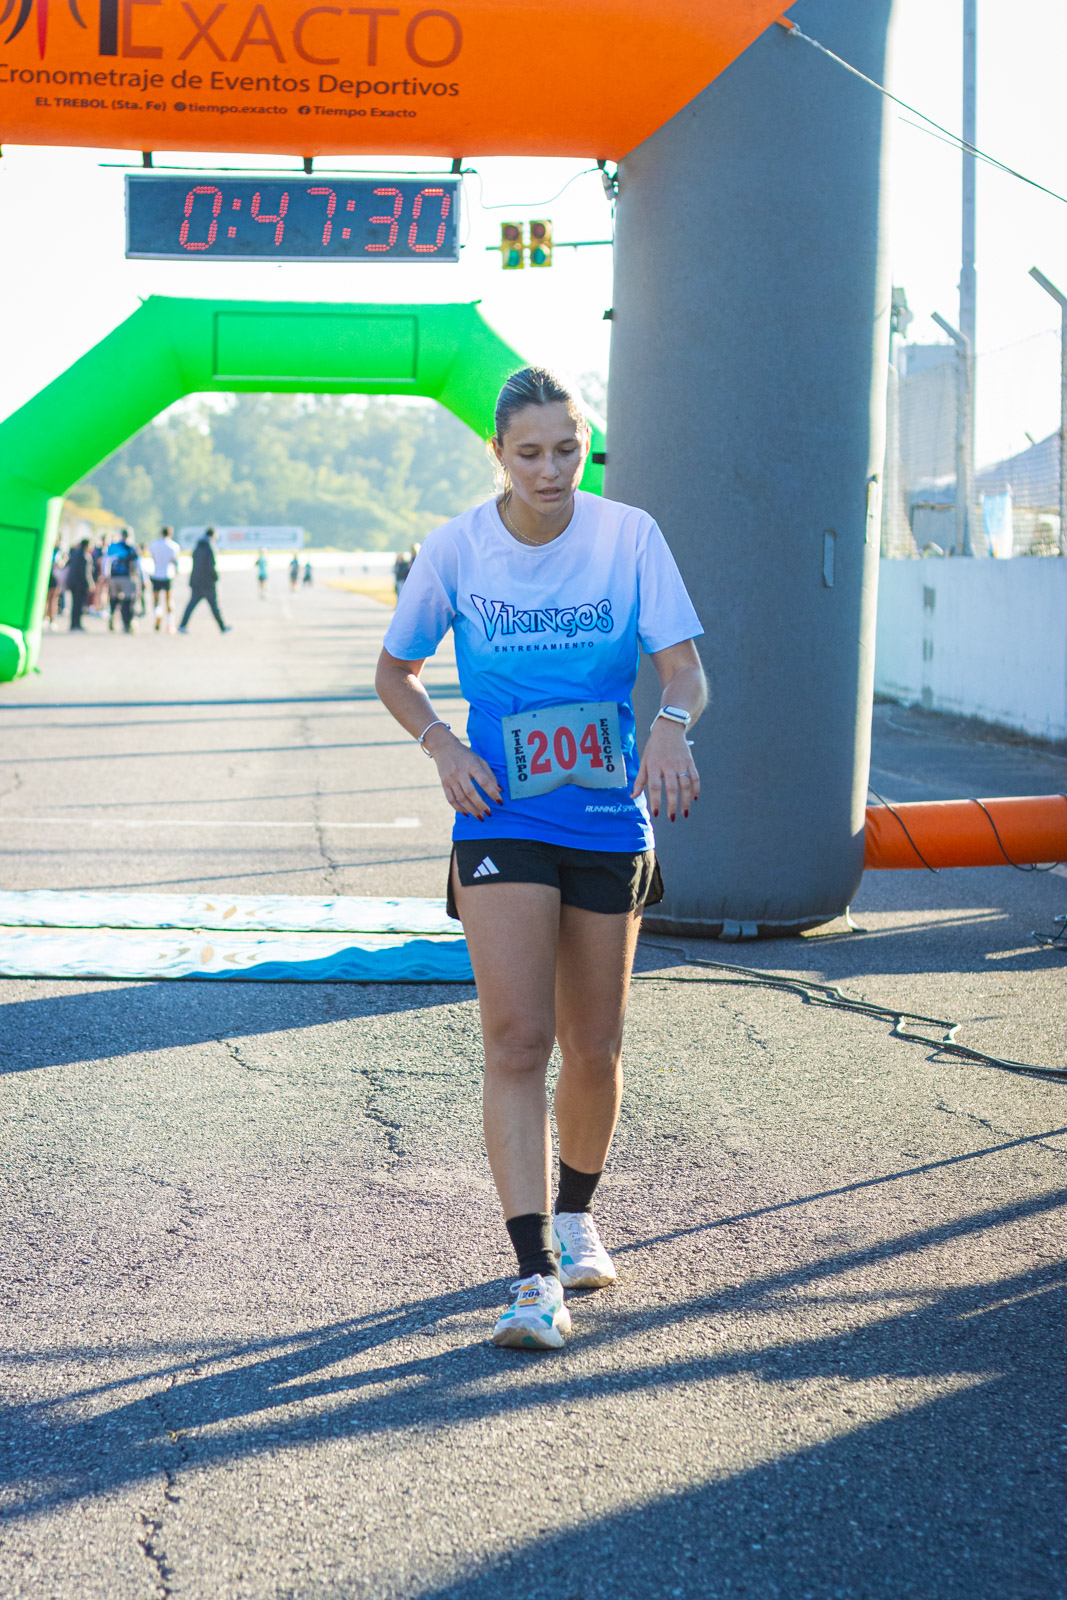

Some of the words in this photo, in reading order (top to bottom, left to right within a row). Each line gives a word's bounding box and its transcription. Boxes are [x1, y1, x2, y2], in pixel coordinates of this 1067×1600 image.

[0, 63, 164, 92] Cronometraje
[171, 70, 202, 89] de
[211, 72, 310, 92] Eventos
[319, 75, 460, 98] Deportivos
[36, 97, 51, 107] EL
[54, 98, 108, 109] TREBOL
[111, 100, 142, 110] (Sta.
[146, 101, 167, 112] Fe)
[189, 103, 288, 115] tiempo.exacto
[313, 106, 367, 118] Tiempo
[370, 108, 417, 118] Exacto
[179, 186, 451, 253] 0:47:30
[494, 641, 595, 653] ENTRENAMIENTO
[511, 729, 528, 782] TIEMPO
[527, 723, 604, 775] 204
[599, 718, 616, 773] EXACTO
